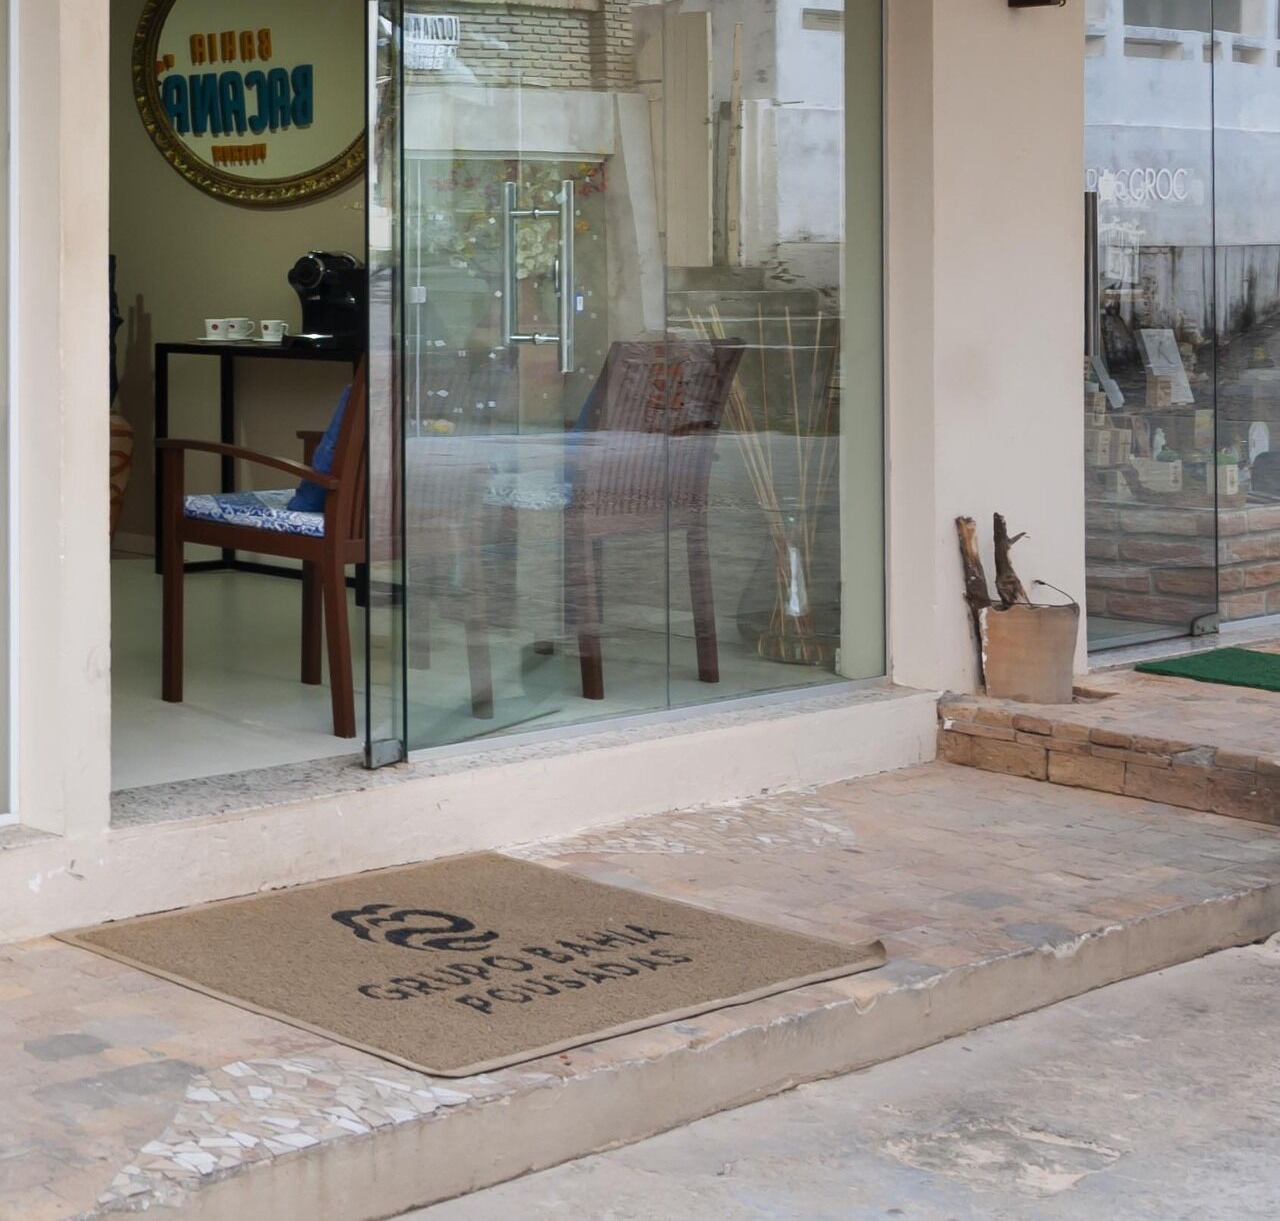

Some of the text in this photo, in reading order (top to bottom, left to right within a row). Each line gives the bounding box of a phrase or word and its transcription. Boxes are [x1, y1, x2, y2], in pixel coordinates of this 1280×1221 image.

[358, 924, 672, 1000] GRUPO BAHIA
[454, 949, 694, 1014] POUSADAS
